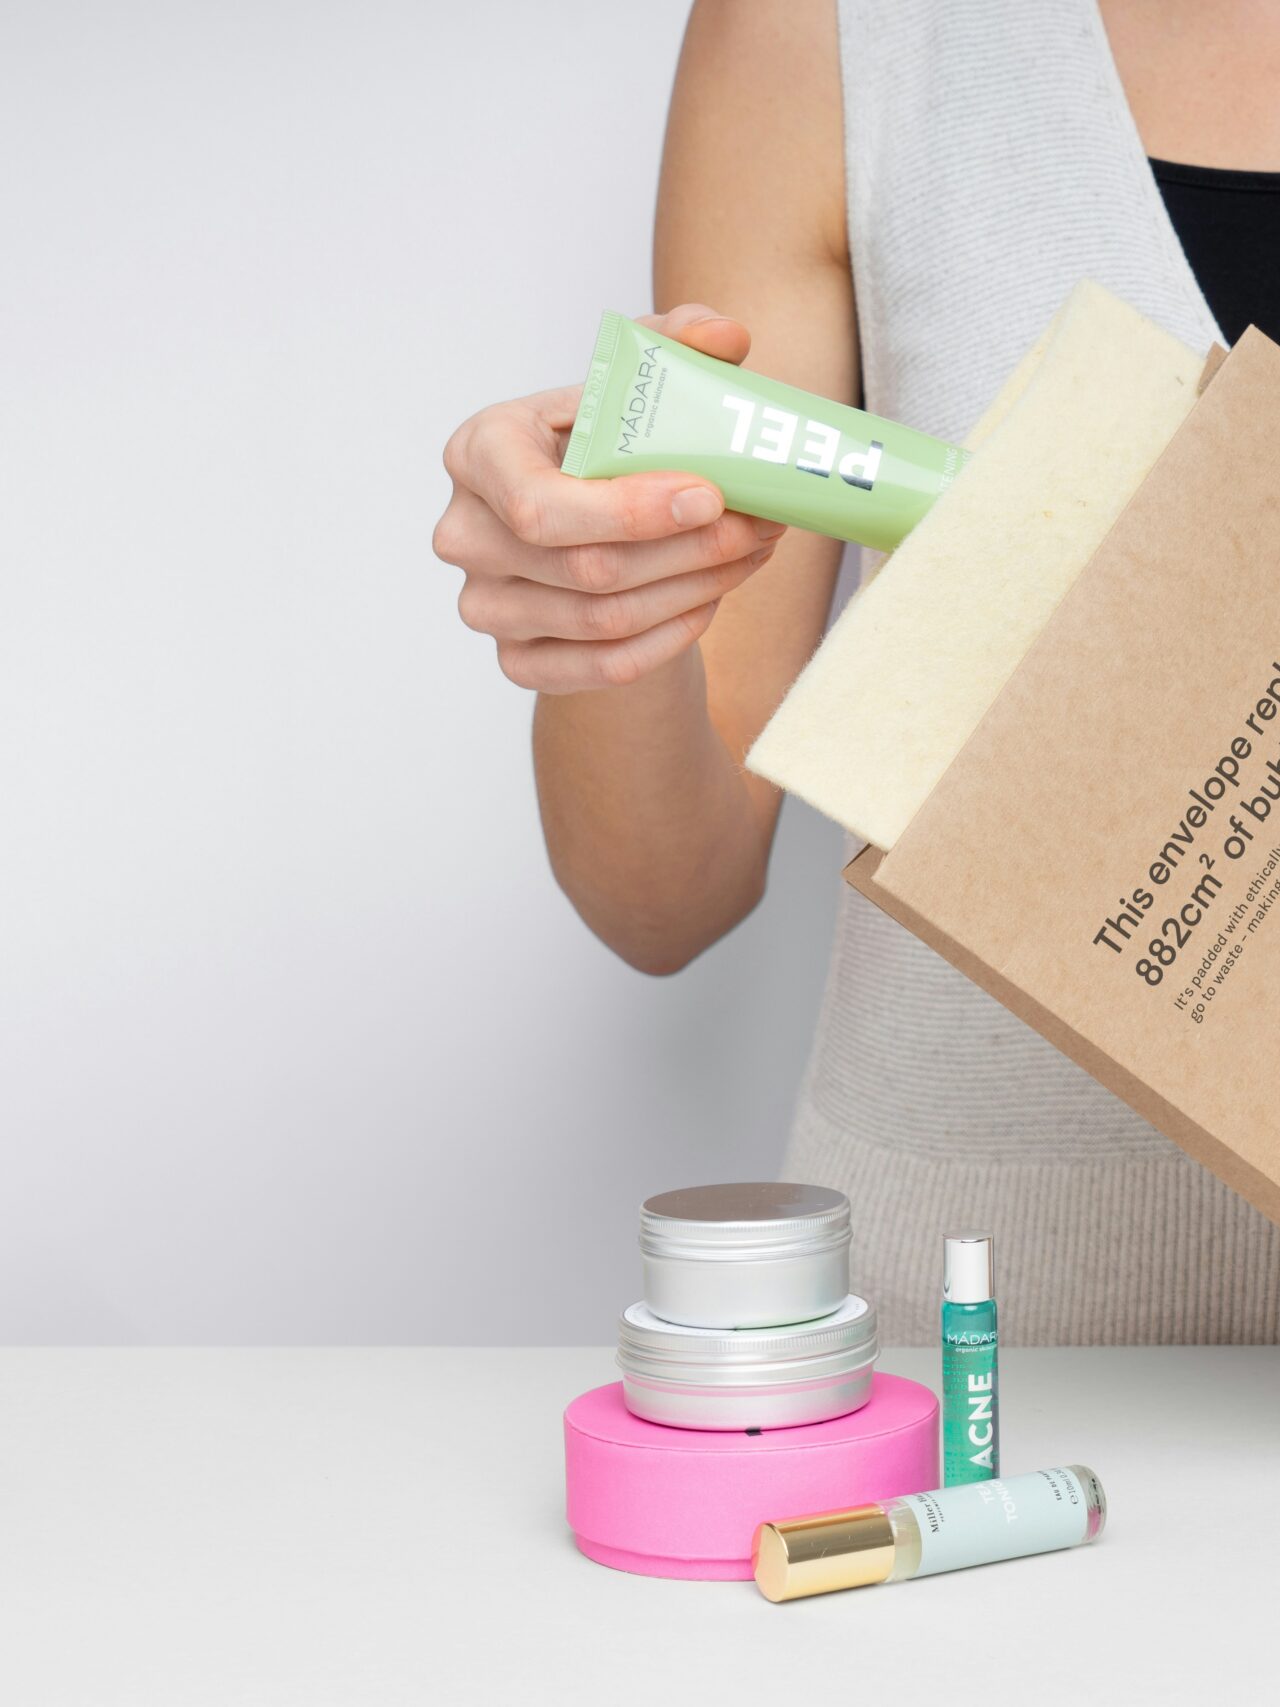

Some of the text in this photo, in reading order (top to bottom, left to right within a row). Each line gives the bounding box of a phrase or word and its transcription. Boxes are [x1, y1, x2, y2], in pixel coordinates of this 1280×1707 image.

[617, 345, 662, 454] MÁDARA
[644, 367, 668, 438] organic skincare
[722, 394, 883, 492] PEEL
[1092, 887, 1155, 954] This
[1148, 736, 1253, 886] envelope
[1223, 814, 1255, 860] of
[1190, 1002, 1206, 1024] go
[1201, 986, 1217, 1002] to
[1212, 944, 1244, 985] waste
[1191, 932, 1228, 990] padded
[1224, 903, 1249, 934] with
[967, 1372, 993, 1469] ACNE
[925, 1503, 940, 1533] Miller
